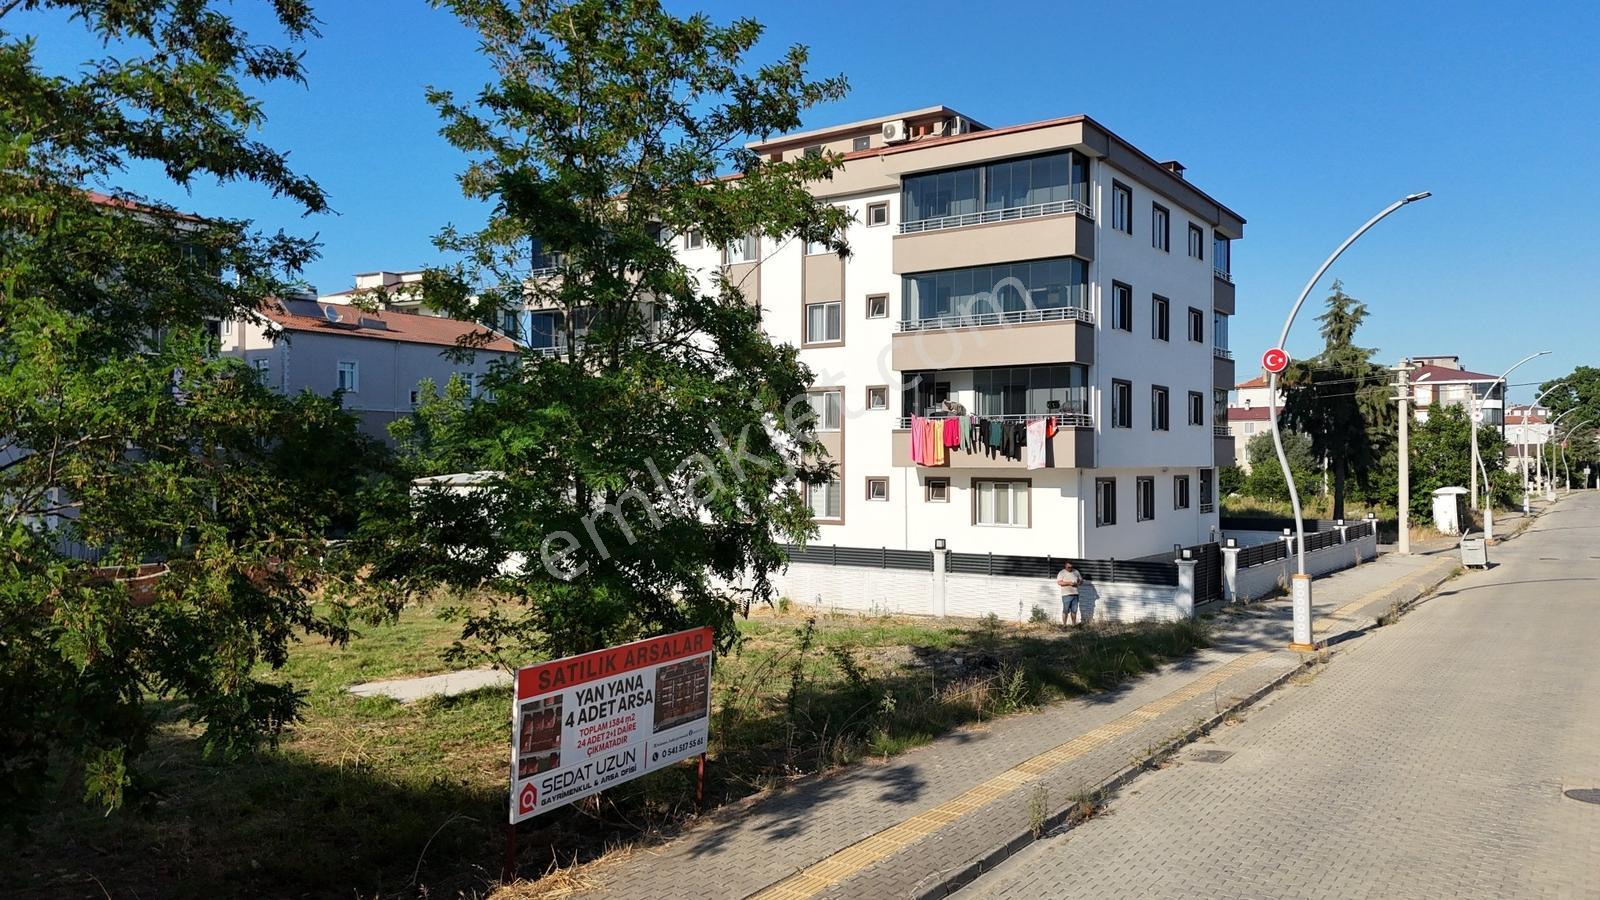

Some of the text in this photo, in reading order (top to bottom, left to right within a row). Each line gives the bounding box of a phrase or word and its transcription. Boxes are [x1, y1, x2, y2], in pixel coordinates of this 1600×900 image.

[538, 634, 704, 691] SATILIK ARSALAR
[576, 674, 644, 707] YAN YANA
[565, 689, 653, 728] 4 ADET ARSA
[579, 713, 636, 737] TOPLAM 1384 m2
[577, 722, 637, 749] 24 ADET 2+1 DAİRE
[586, 735, 628, 758] ÇIKMATADIR
[661, 750, 667, 758] 0
[667, 746, 678, 756] 541
[540, 782, 592, 806] GAYRİMENKUL
[600, 773, 619, 784] ARSA
[620, 763, 637, 776] OFİSİ
[542, 748, 636, 795] SEDAT UZUN
